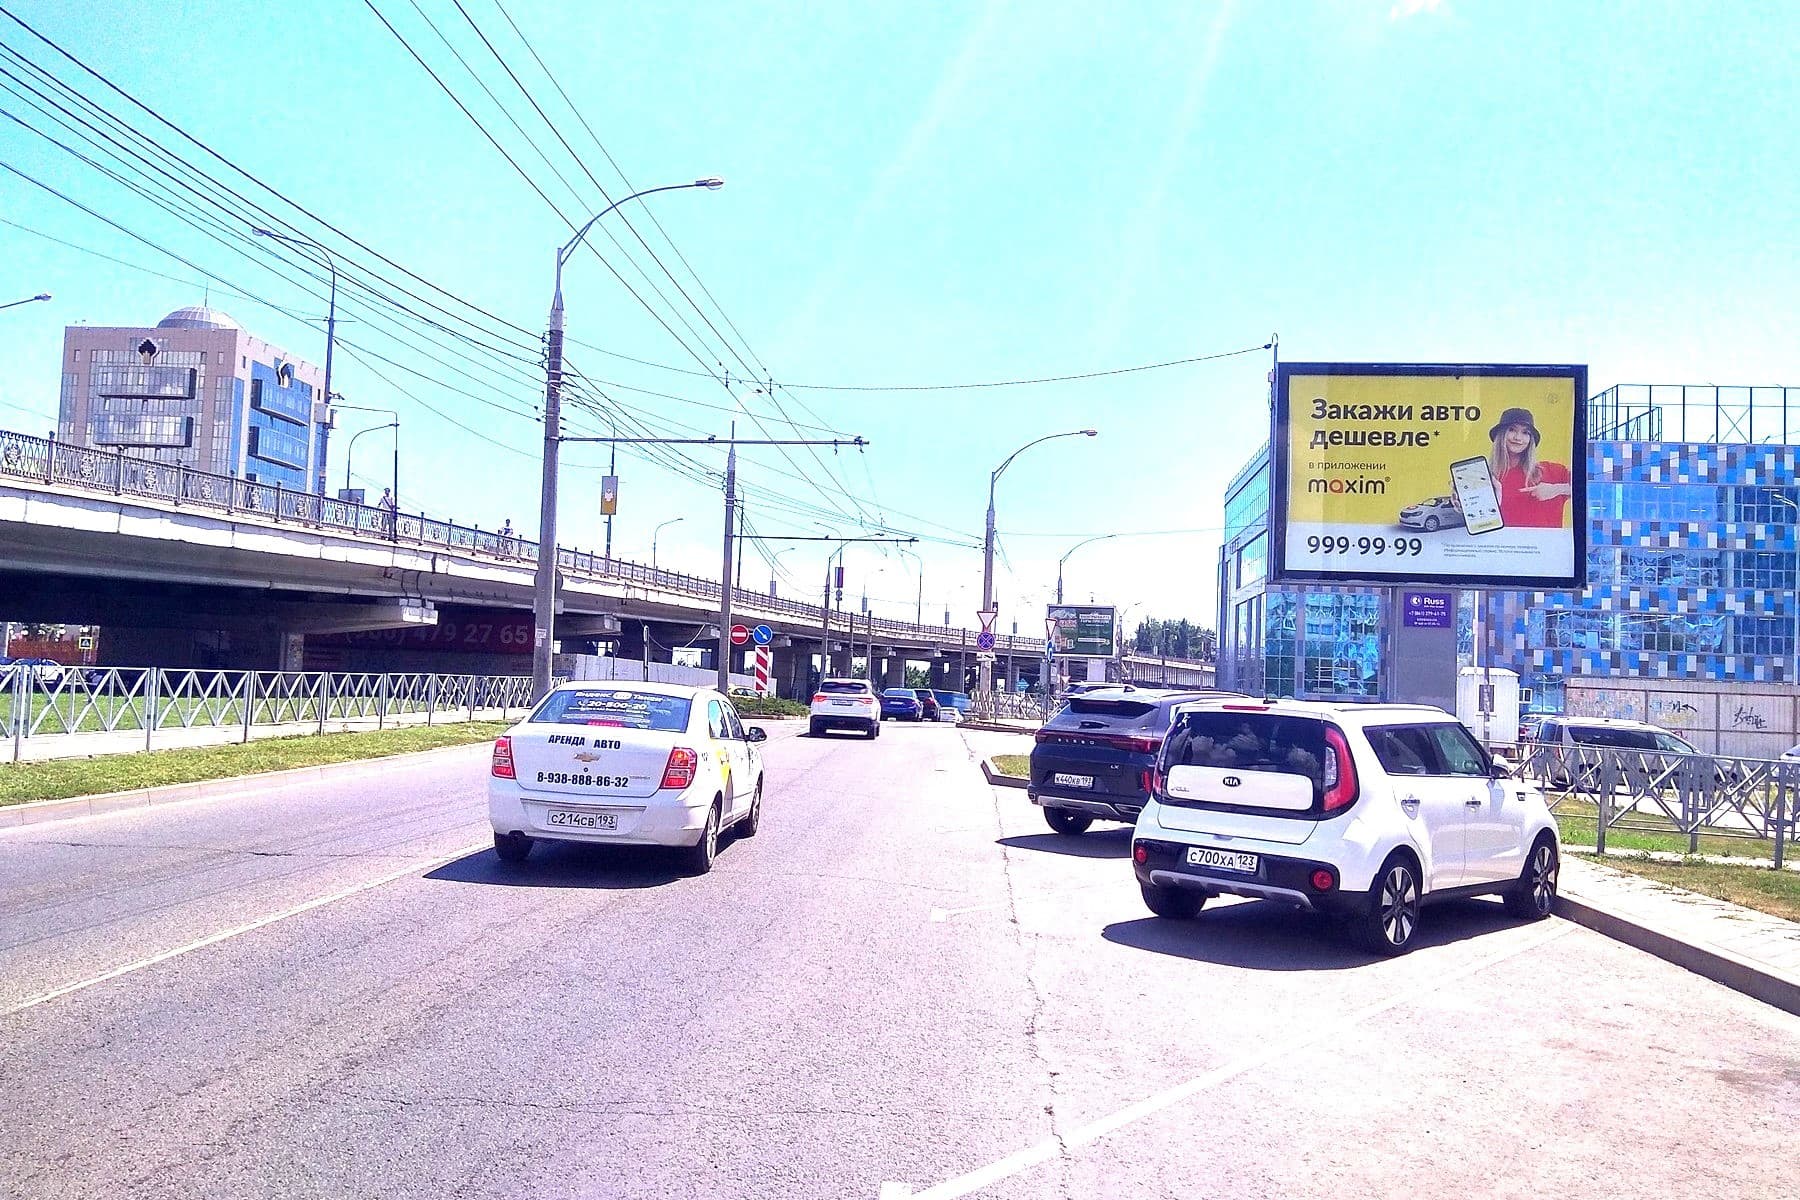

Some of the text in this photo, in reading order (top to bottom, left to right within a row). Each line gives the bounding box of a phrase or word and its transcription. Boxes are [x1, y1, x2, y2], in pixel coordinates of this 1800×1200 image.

[1310, 398, 1481, 422] Закажи авто
[1308, 460, 1386, 471] в приложении
[1423, 597, 1445, 605] Russ
[463, 623, 493, 644] 27
[499, 623, 529, 645] 65
[548, 734, 621, 750] АРЕНДА АВТО
[537, 771, 629, 788] 8-938-888-86-32
[1223, 777, 1239, 787] KIA
